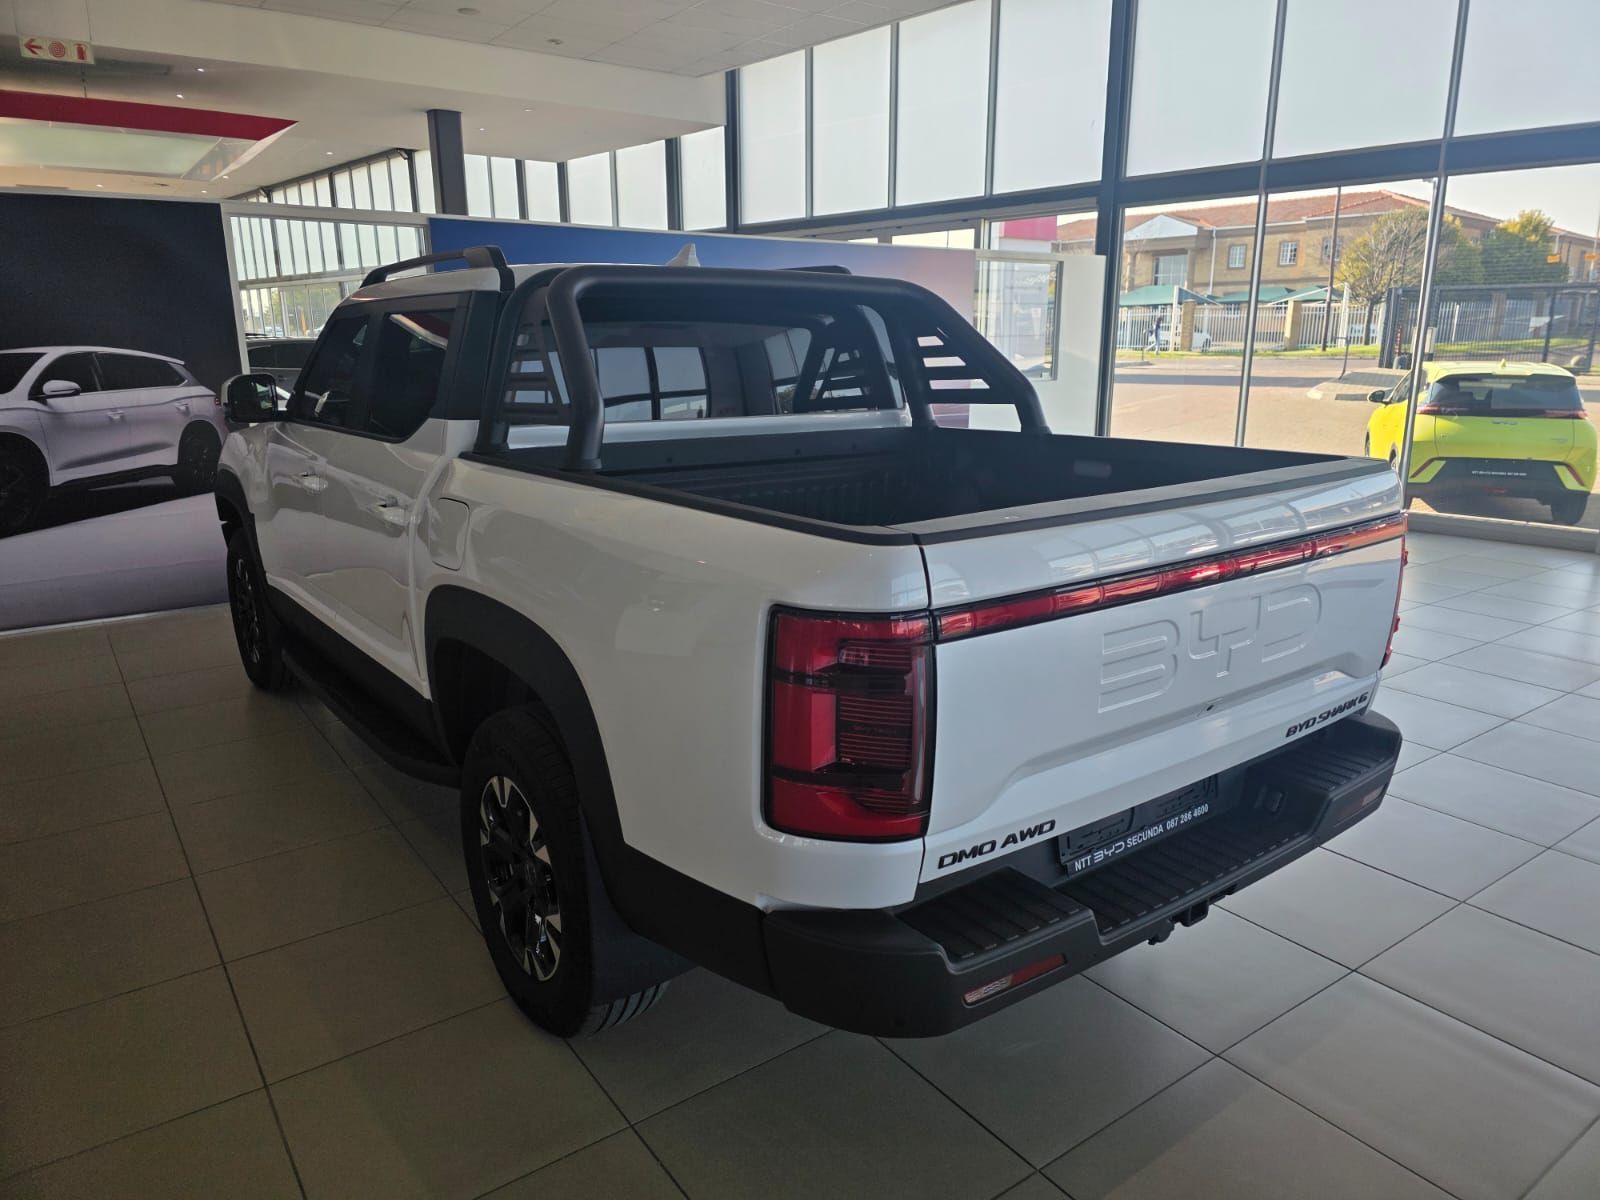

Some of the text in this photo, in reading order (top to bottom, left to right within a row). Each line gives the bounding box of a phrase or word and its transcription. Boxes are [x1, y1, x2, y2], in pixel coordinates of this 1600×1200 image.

[1097, 583, 1322, 714] BYD
[1285, 691, 1369, 738] BYD SHARK 6
[937, 819, 1056, 870] DMO AWD
[1074, 803, 1209, 872] NTT BYD SECUNDA 087 286 4600
